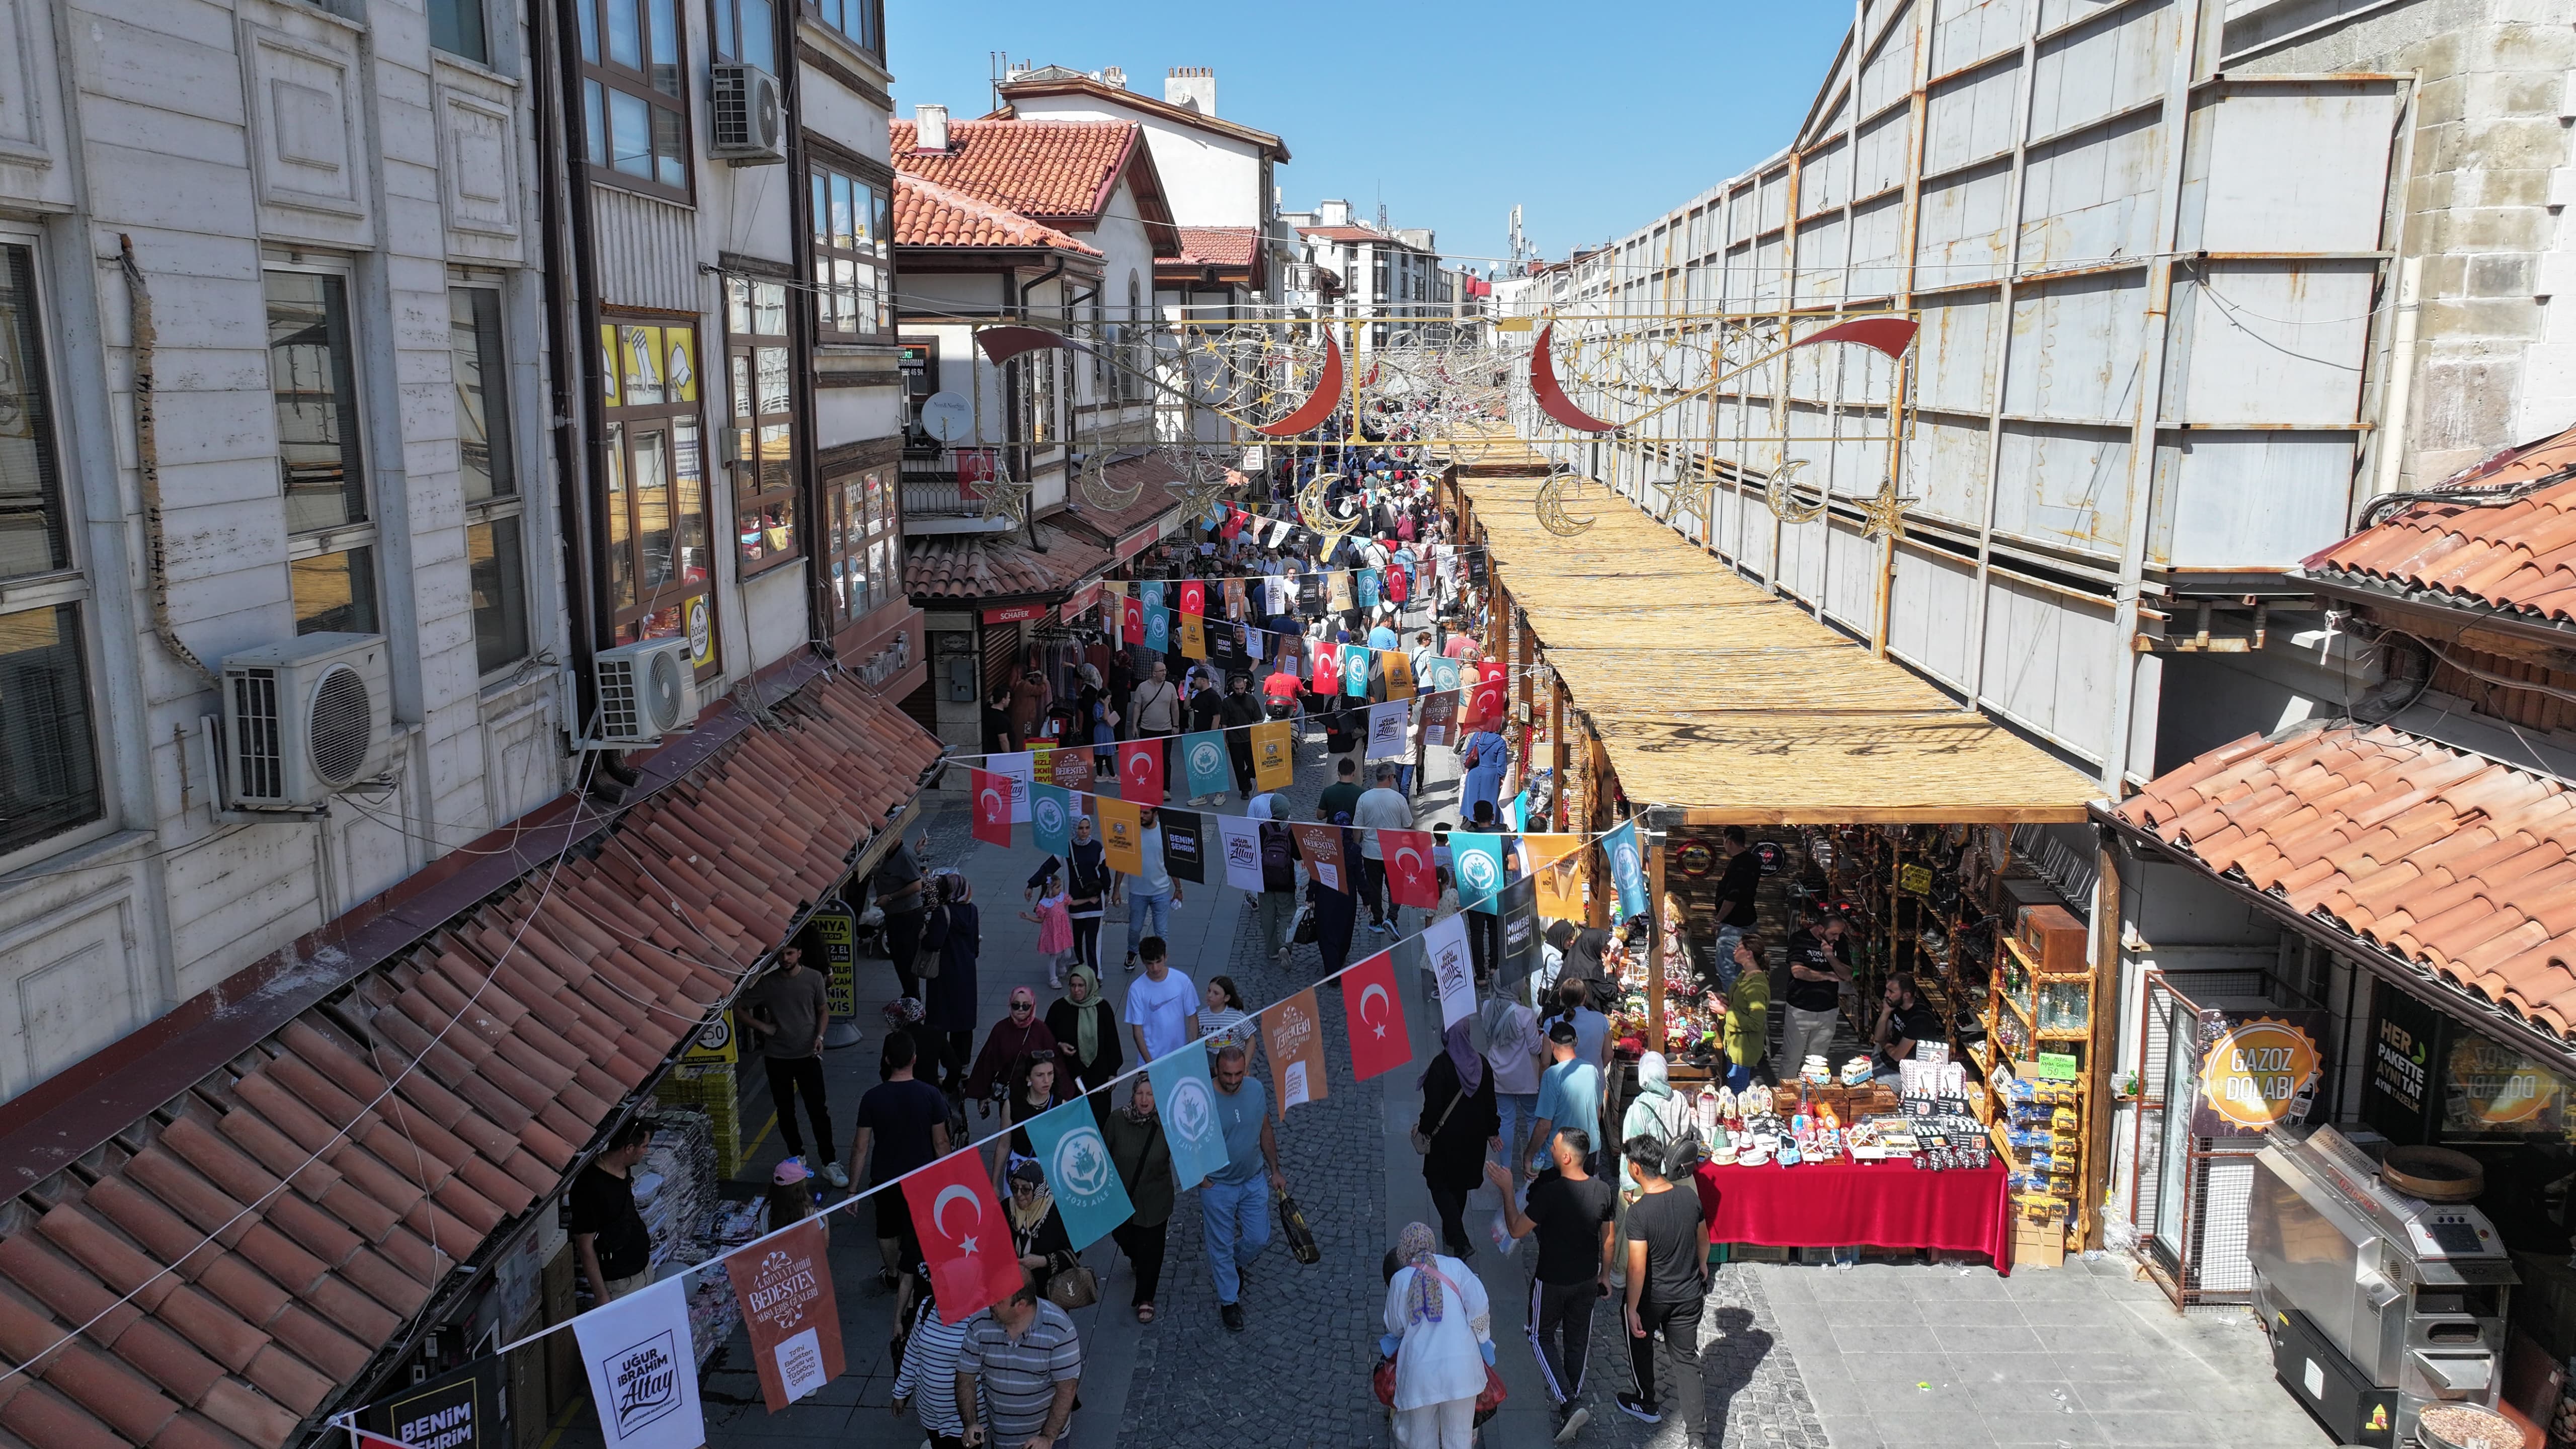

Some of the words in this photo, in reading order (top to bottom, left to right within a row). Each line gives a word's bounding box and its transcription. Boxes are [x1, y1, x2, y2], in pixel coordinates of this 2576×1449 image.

[1247, 452, 1257, 465] E
[845, 481, 862, 505] TERZİ
[1376, 726, 1398, 739] Altay
[1169, 834, 1194, 845] BENİM
[1171, 842, 1195, 853] ŞEHRİM
[1230, 847, 1254, 863] Altay
[830, 946, 837, 954] 2.
[2381, 1018, 2412, 1055] HER
[2047, 1067, 2058, 1076] 50
[2231, 1048, 2294, 1072] GAZOZ
[2377, 1043, 2424, 1084] PAKETTE
[2226, 1076, 2294, 1100] DOLABI
[2376, 1061, 2401, 1086] AYNI
[2402, 1076, 2423, 1100] TAT
[2375, 1076, 2391, 1095] AYNI
[2391, 1089, 2420, 1114] TAZELİK
[1066, 1194, 1087, 1208] 2025
[1091, 1190, 1109, 1206] AİLE
[749, 1268, 816, 1314] BEDESTEN
[622, 1348, 659, 1372] UĞUR
[784, 1349, 813, 1367] Bedesten
[789, 1344, 804, 1357] Tarihi
[617, 1354, 668, 1388] İBRAHİM
[620, 1370, 673, 1423] Altay
[401, 1402, 470, 1443] BENİM
[415, 1423, 472, 1449] EHRİM
